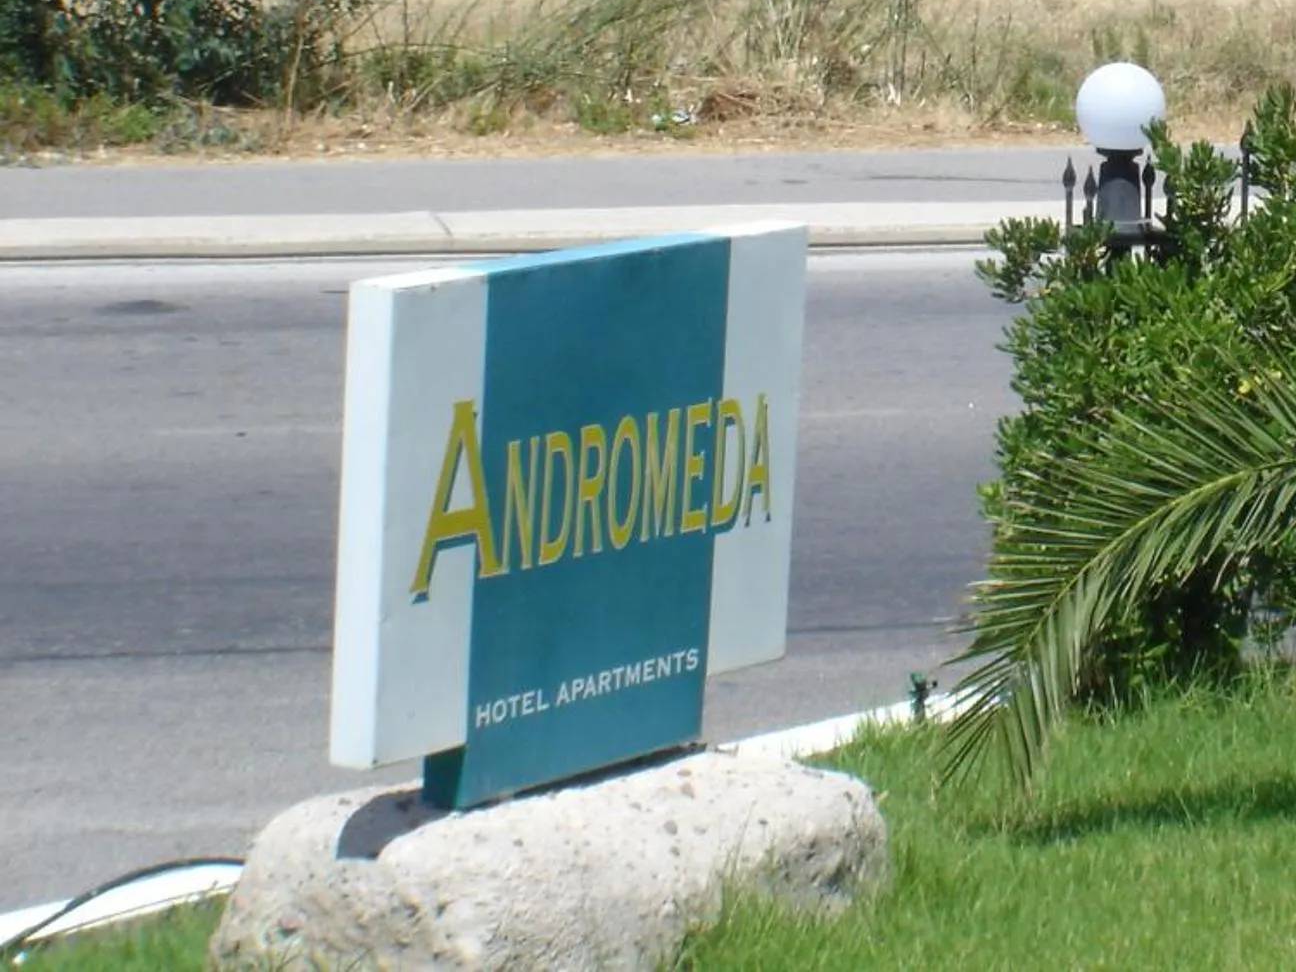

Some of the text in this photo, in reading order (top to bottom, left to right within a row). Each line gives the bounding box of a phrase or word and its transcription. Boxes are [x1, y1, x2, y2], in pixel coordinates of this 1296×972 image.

[410, 393, 772, 601] ANDROMEDA
[475, 648, 699, 727] HOTEL APARTMENTS
